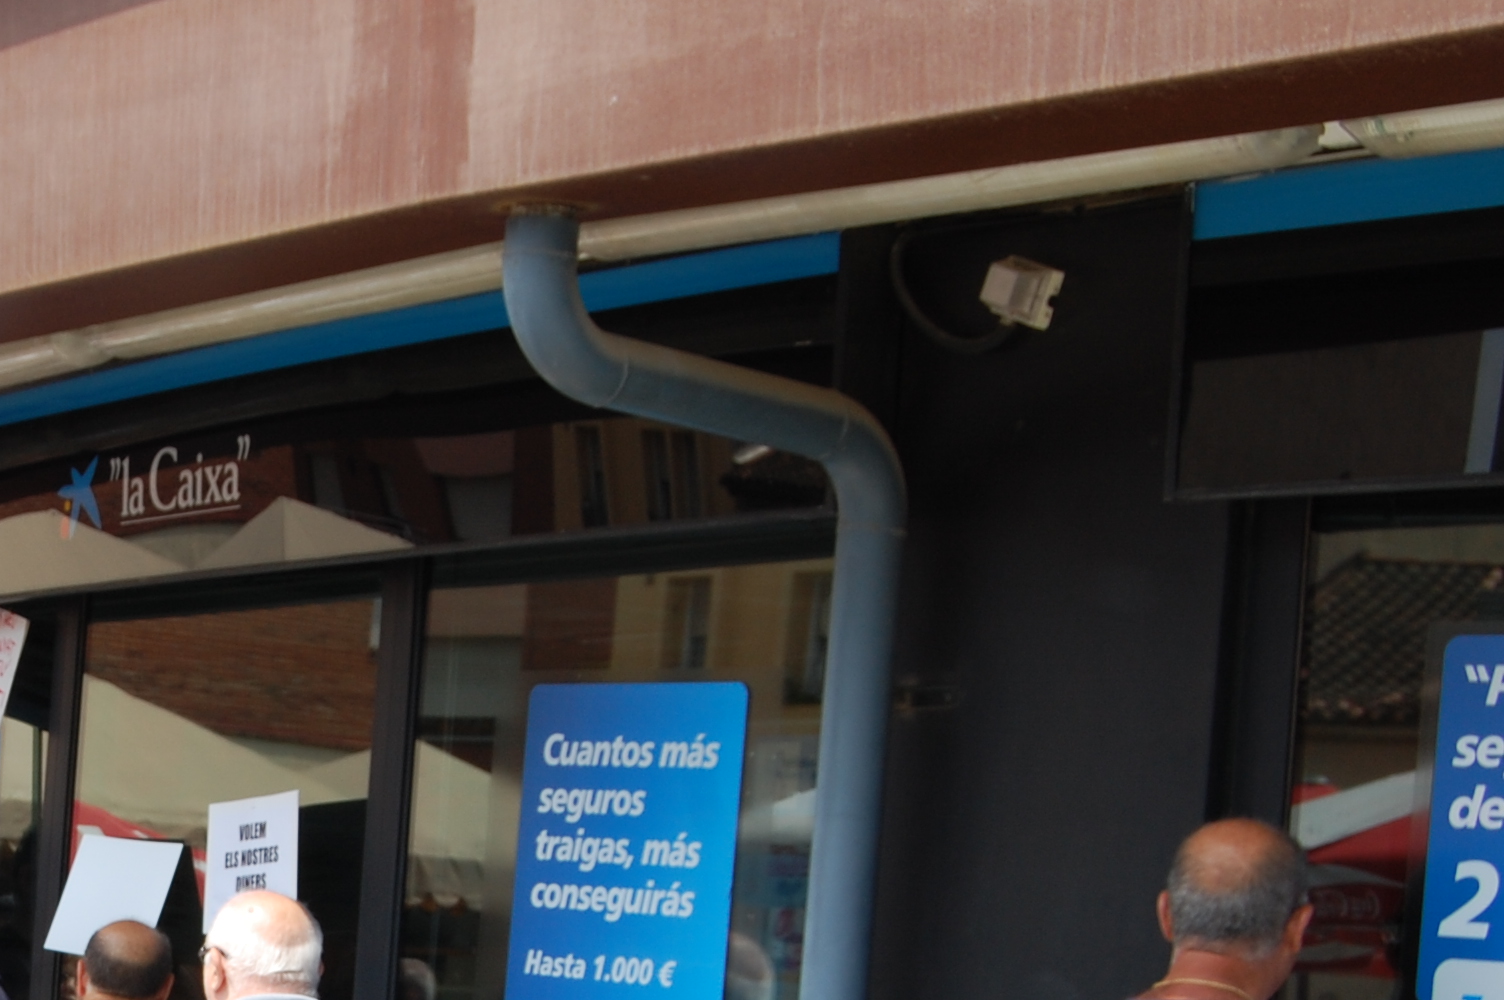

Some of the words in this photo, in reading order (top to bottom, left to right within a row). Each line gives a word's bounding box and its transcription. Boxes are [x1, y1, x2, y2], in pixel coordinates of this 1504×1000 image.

[148, 434, 251, 511] Caixa"
[542, 733, 655, 768] Cuantos
[658, 733, 721, 769] más
[1451, 734, 1504, 779] se
[537, 787, 646, 823] seguros
[239, 821, 267, 841] VOLEM
[535, 828, 634, 872] traigas,
[641, 832, 702, 868] más
[225, 851, 239, 869] ELS
[240, 845, 279, 866] NOSTRES
[530, 880, 695, 922] conseguirás
[1437, 859, 1500, 940] 2
[524, 949, 586, 979] Hasta
[594, 955, 654, 986] 1.000
[657, 961, 677, 988] €
